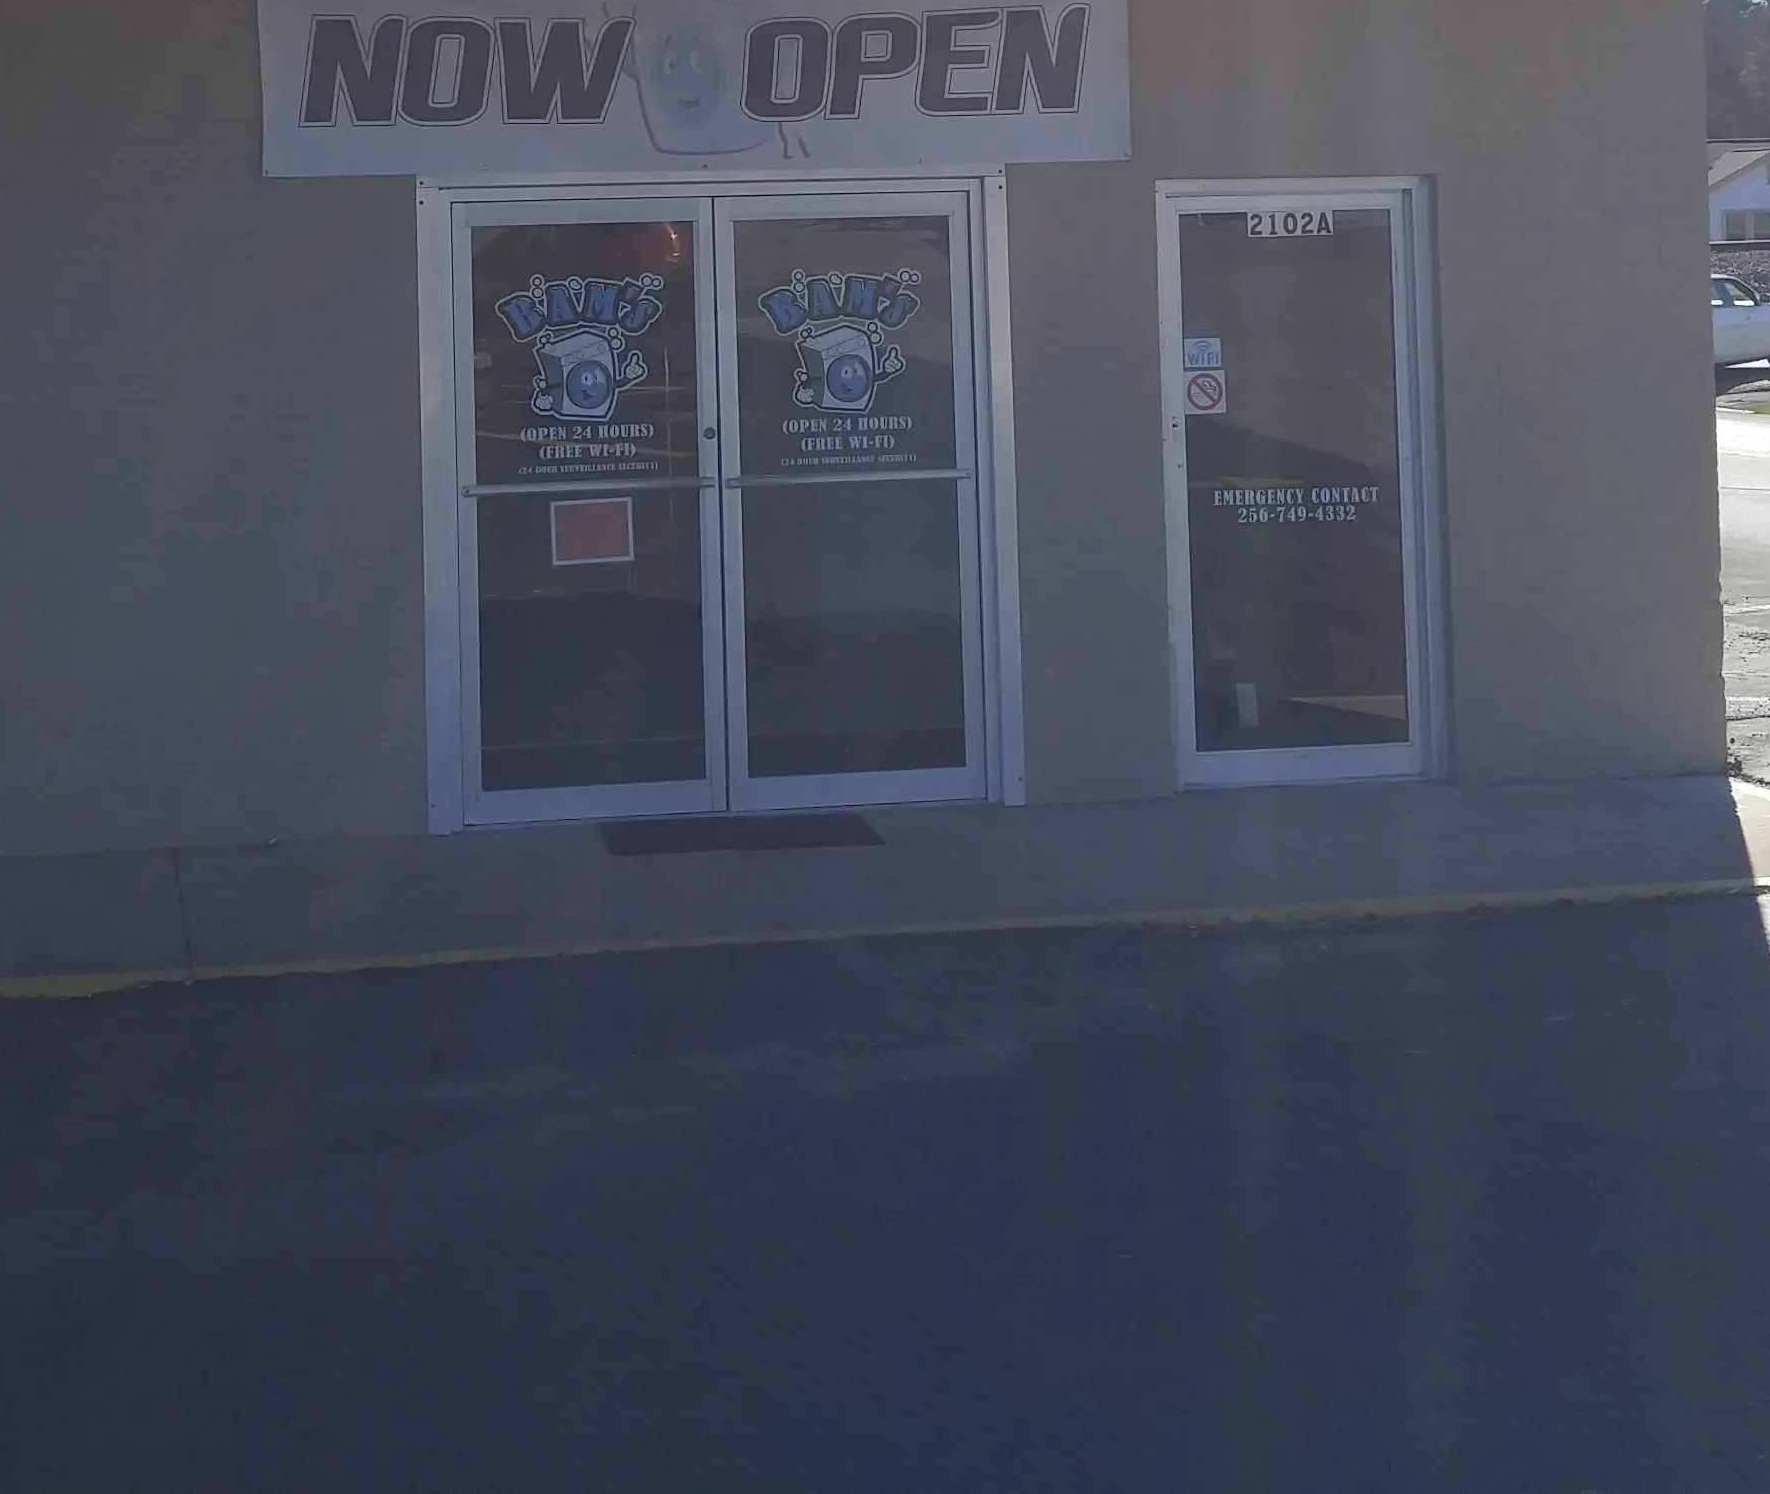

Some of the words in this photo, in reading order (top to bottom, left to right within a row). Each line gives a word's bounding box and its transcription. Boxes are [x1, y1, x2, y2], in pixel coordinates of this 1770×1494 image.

[298, 12, 636, 127] NOW
[740, 3, 1091, 123] OPEN
[1249, 211, 1332, 236] 2102A
[500, 282, 657, 338] BAM'S
[763, 275, 916, 332] BAM'S
[572, 425, 592, 440] 24
[832, 417, 852, 432] 24
[1213, 489, 1304, 506] EMERGENCY
[1311, 486, 1379, 504] CONTACT
[1237, 506, 1356, 523] 256-749-4332
